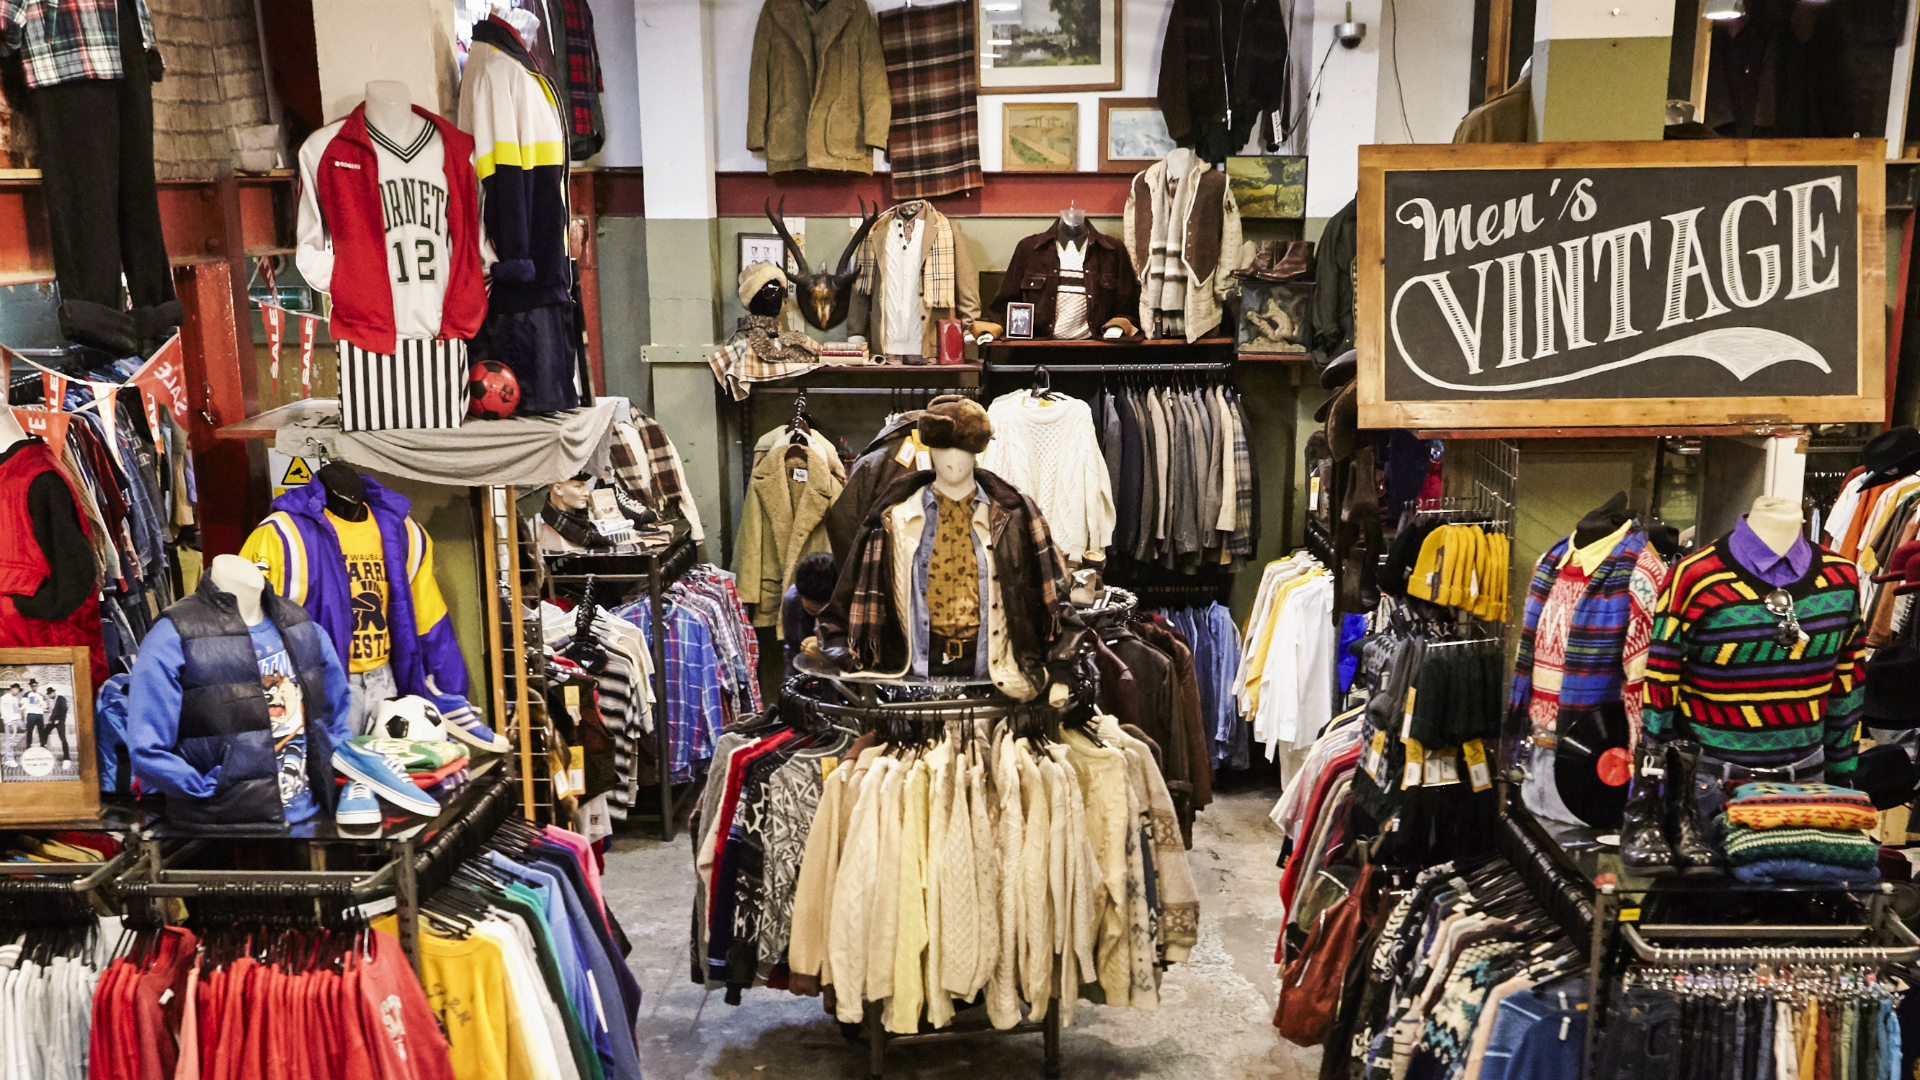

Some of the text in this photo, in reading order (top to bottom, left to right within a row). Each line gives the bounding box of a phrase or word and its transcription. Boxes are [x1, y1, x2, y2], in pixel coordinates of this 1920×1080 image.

[378, 178, 450, 248] ORNET
[1396, 177, 1598, 262] Men's
[393, 239, 436, 283] 12
[1391, 176, 1842, 376] VINTAGE
[269, 308, 280, 379] SALE
[302, 317, 314, 386] SALE
